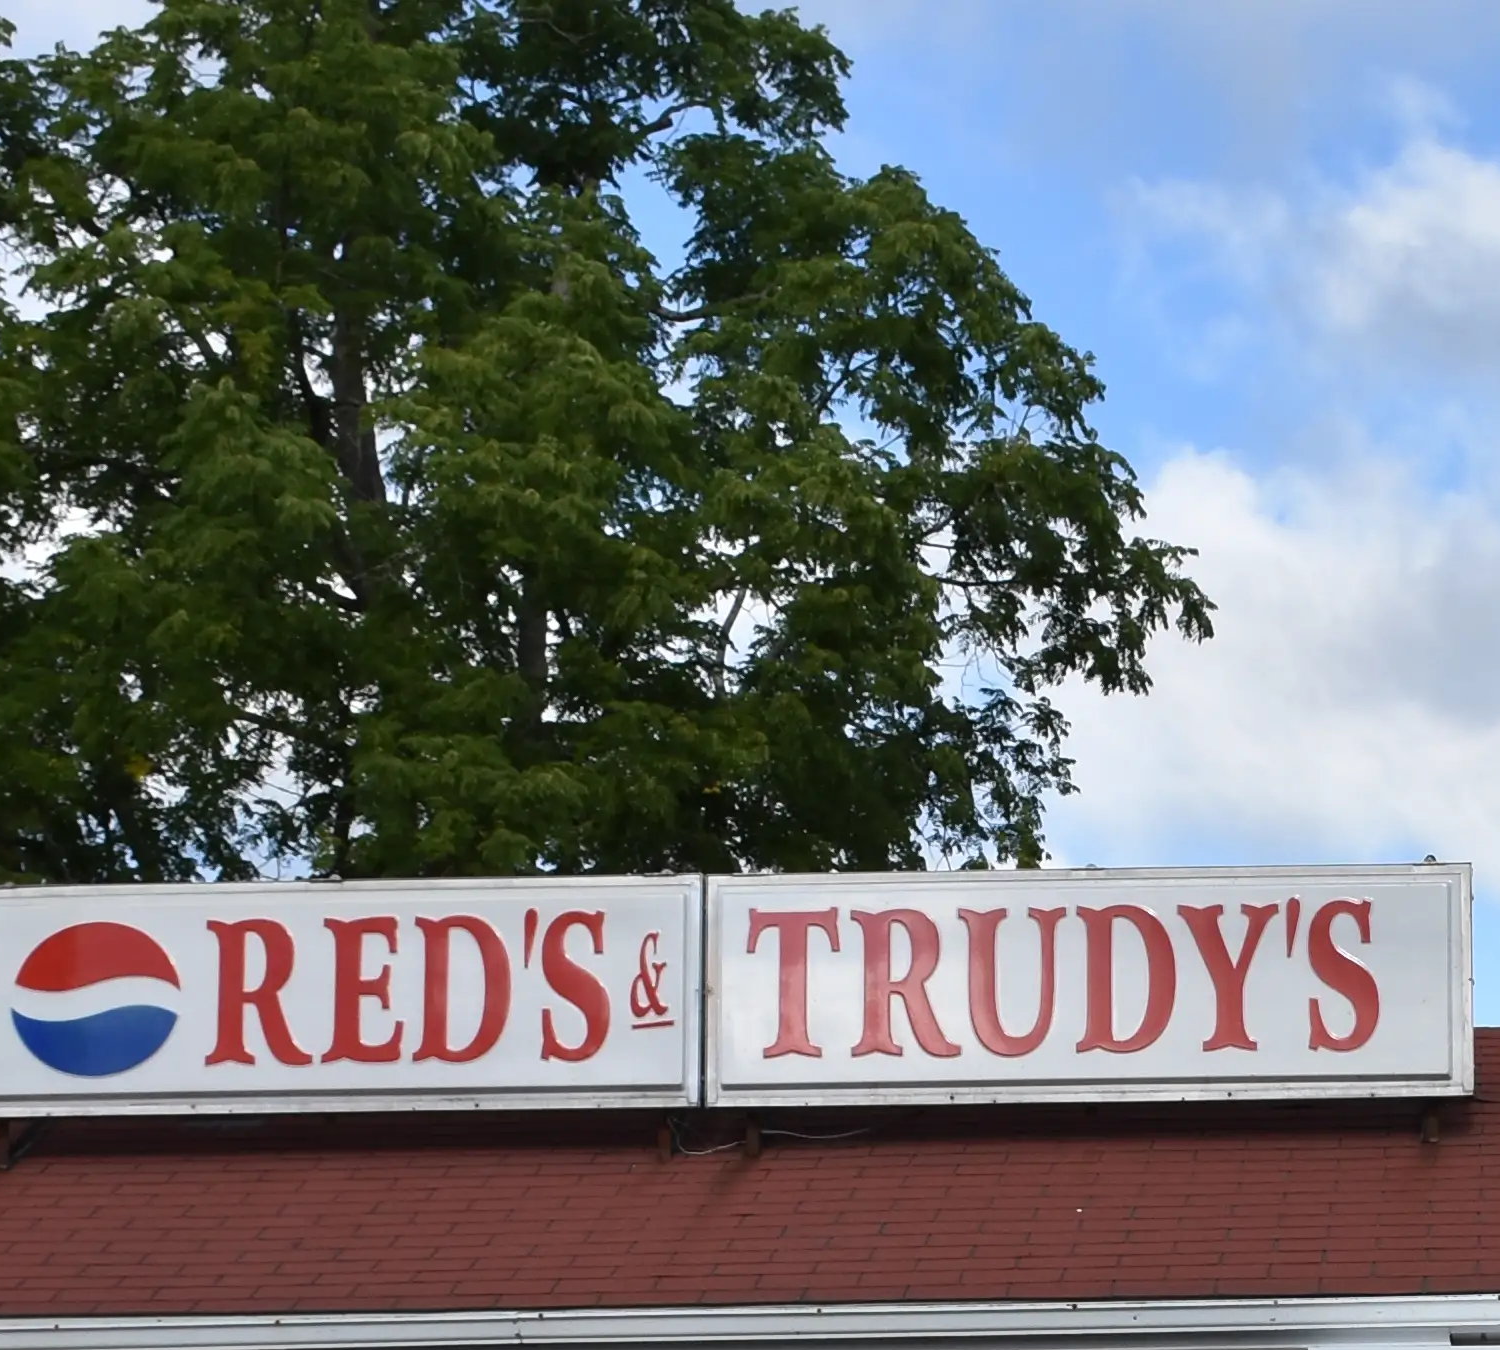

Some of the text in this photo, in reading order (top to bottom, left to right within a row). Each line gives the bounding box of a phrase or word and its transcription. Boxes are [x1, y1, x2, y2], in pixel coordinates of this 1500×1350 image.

[204, 896, 1381, 1066] RED'S & TRUDY'S
